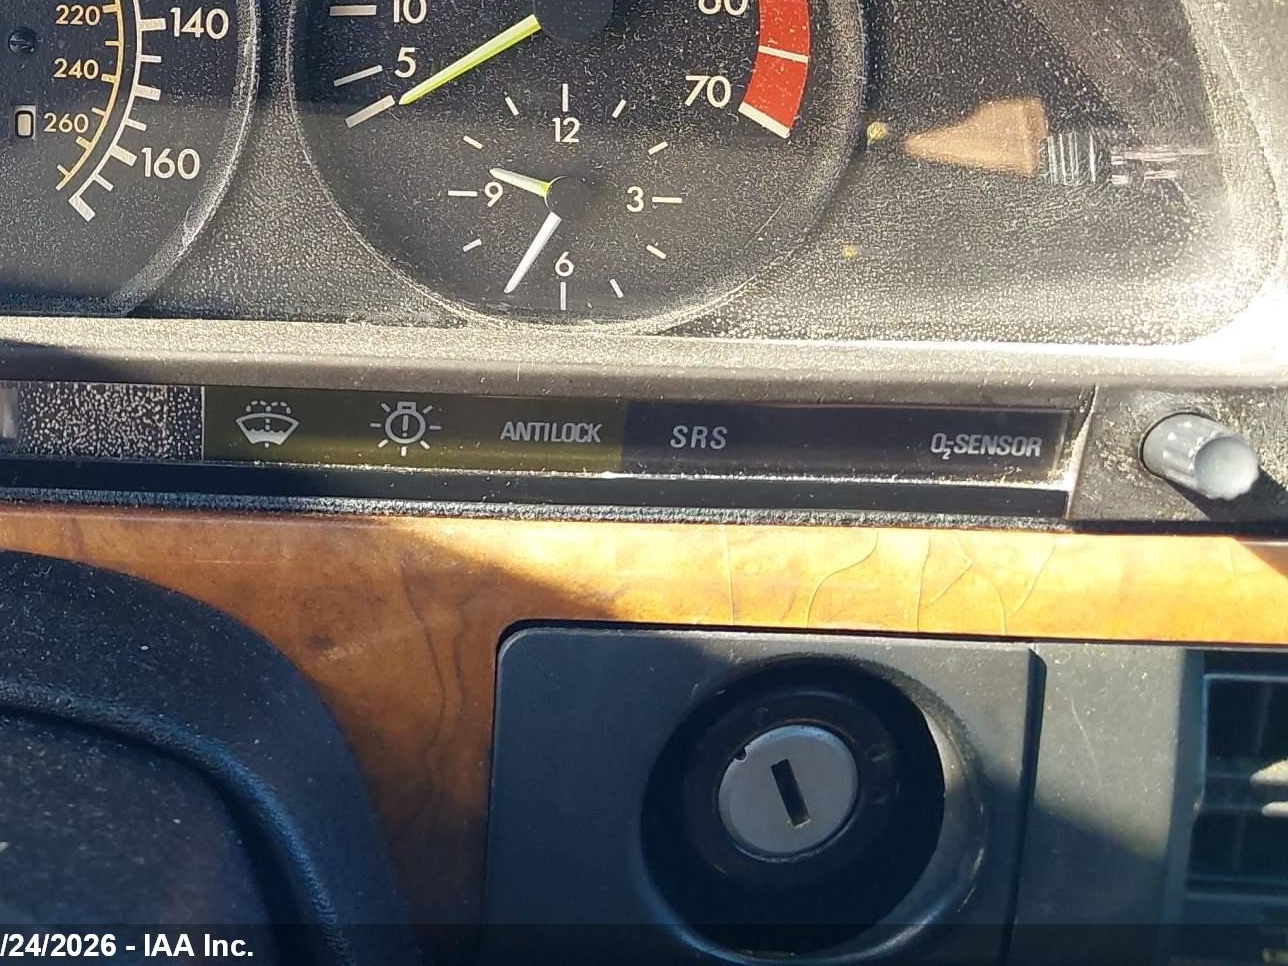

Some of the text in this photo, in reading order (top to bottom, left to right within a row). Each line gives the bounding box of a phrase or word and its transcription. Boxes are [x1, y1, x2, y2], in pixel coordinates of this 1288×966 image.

[56, 5, 101, 26] 220
[170, 8, 229, 39] 140
[53, 59, 98, 80] 240
[394, 47, 416, 78] 5
[685, 75, 730, 107] 70
[43, 113, 89, 133] 260
[552, 117, 580, 143] 12
[143, 148, 200, 179] 160
[485, 182, 503, 207] 9
[627, 186, 644, 211] 3
[554, 252, 574, 276] 6
[500, 421, 602, 443] ANTILOCK
[672, 426, 728, 449] SRS
